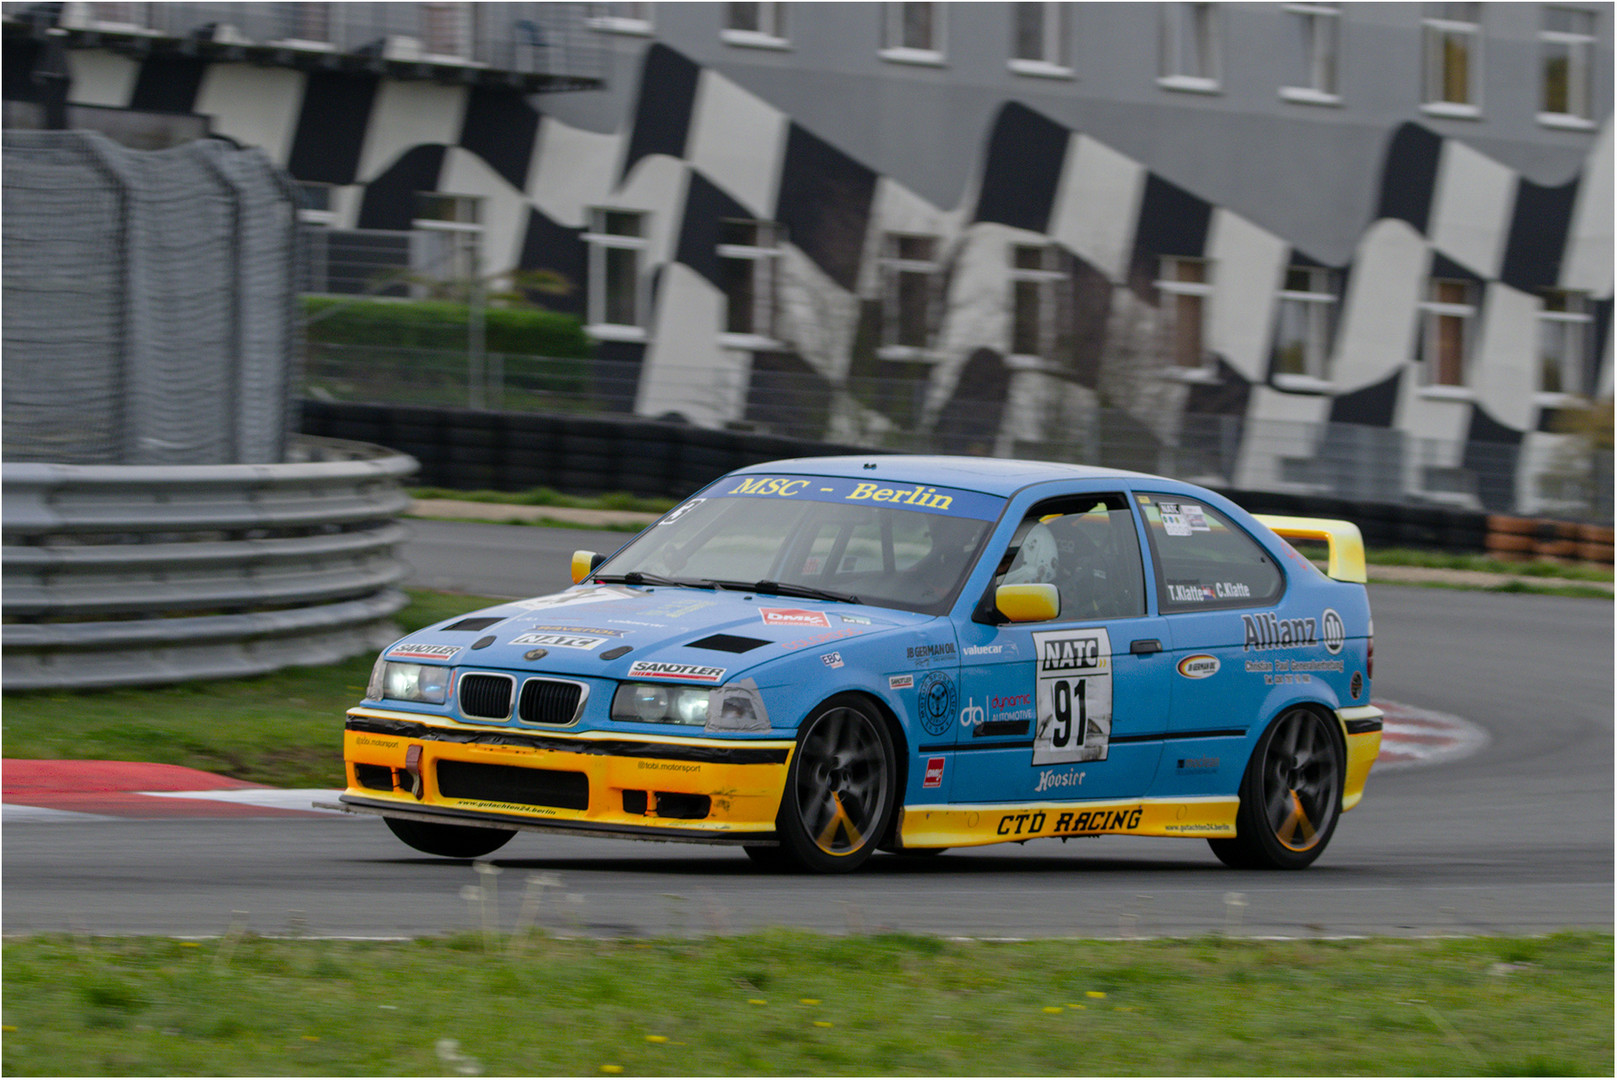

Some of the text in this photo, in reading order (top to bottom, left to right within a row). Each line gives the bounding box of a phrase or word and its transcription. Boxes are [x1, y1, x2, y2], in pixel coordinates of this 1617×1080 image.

[728, 478, 811, 496] MSC
[845, 483, 953, 510] Berlin
[1168, 582, 1251, 601] T.Klatte C.Klatte
[1241, 611, 1318, 651] Allianz
[519, 634, 594, 648] NATC
[394, 644, 461, 656] SANDTLER
[907, 642, 956, 658] JB GERMAN OIL
[963, 644, 1003, 656] valuecar
[1044, 639, 1097, 669] NATC
[822, 653, 841, 666] EBC
[634, 662, 724, 676] SANDTLER
[991, 693, 1031, 712] dynamic
[992, 708, 1032, 721] AUTOMOTIVE
[1053, 679, 1086, 748] 91
[638, 761, 701, 773] @tobi.motorsport
[1034, 767, 1086, 792] Hoosier
[457, 800, 557, 815] www.gutachten24.berlin
[1054, 809, 1143, 832] RACING
